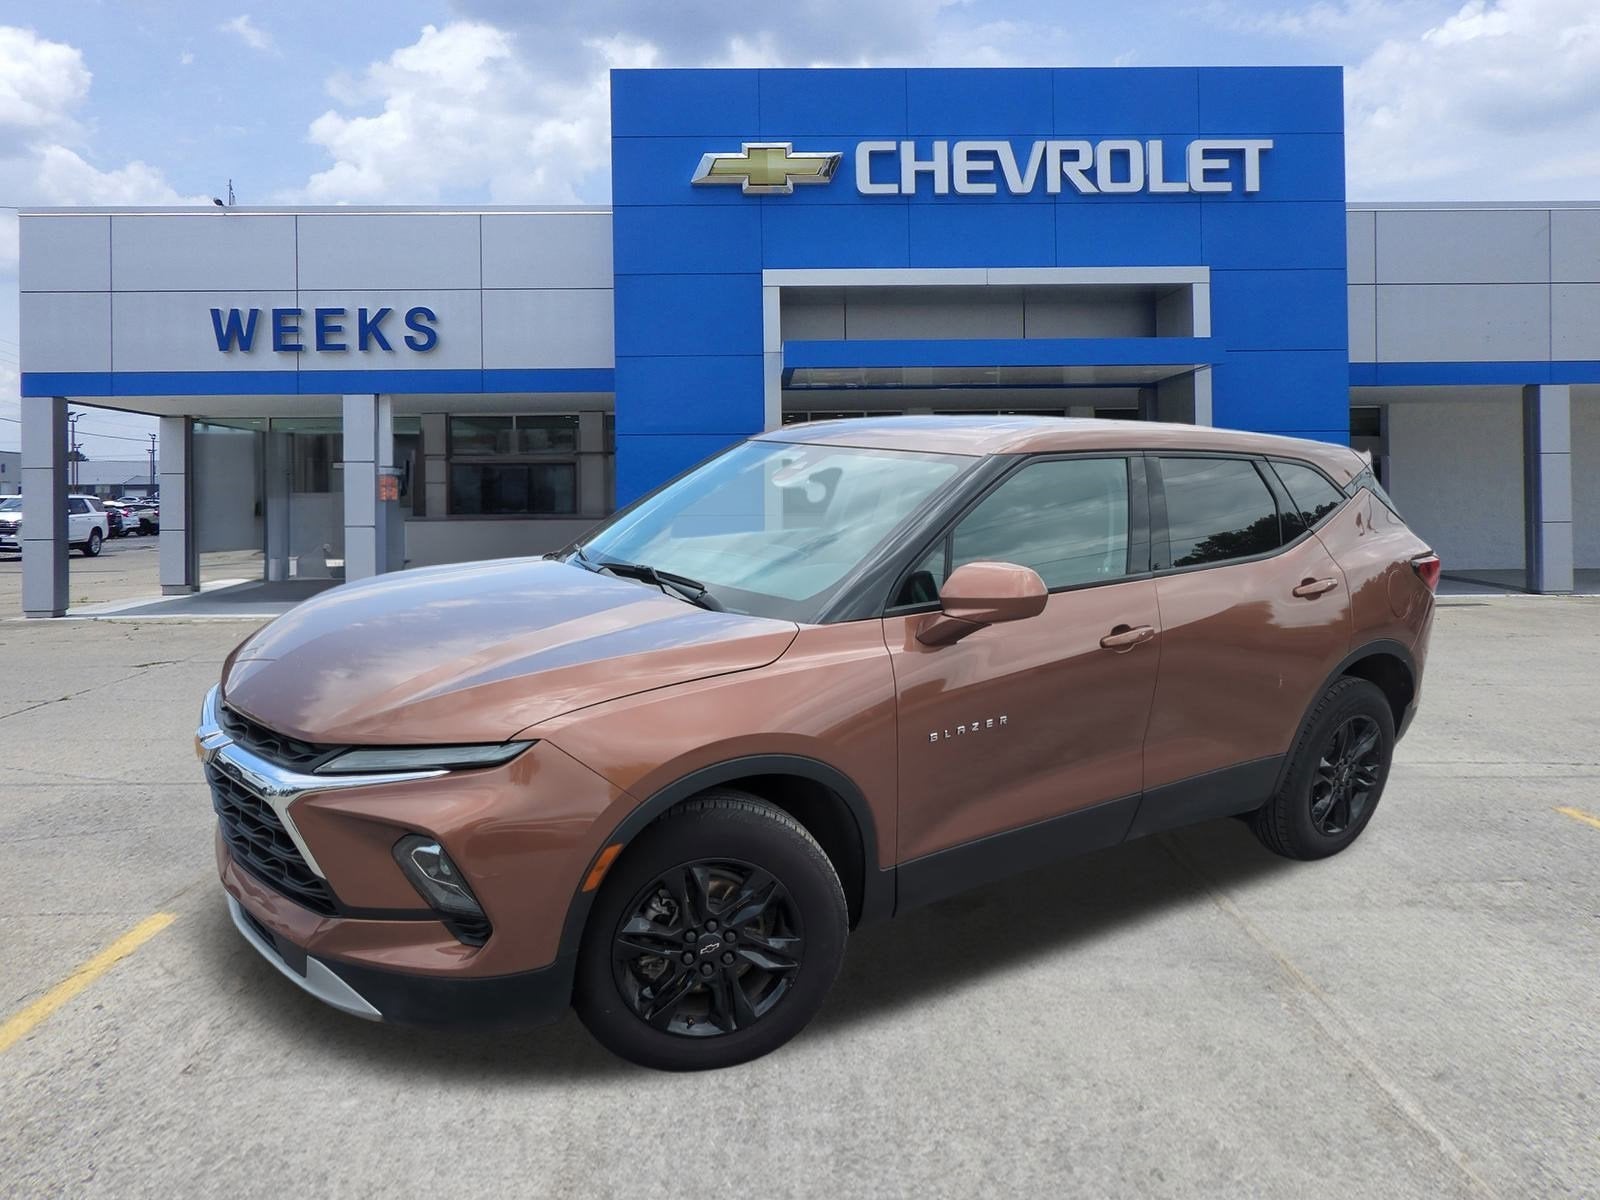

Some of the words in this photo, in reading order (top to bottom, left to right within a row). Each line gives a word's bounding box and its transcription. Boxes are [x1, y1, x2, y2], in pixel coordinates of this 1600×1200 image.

[855, 138, 1274, 195] CHEVROLET
[209, 306, 438, 352] WEEKS
[929, 715, 1008, 742] BLAZER
